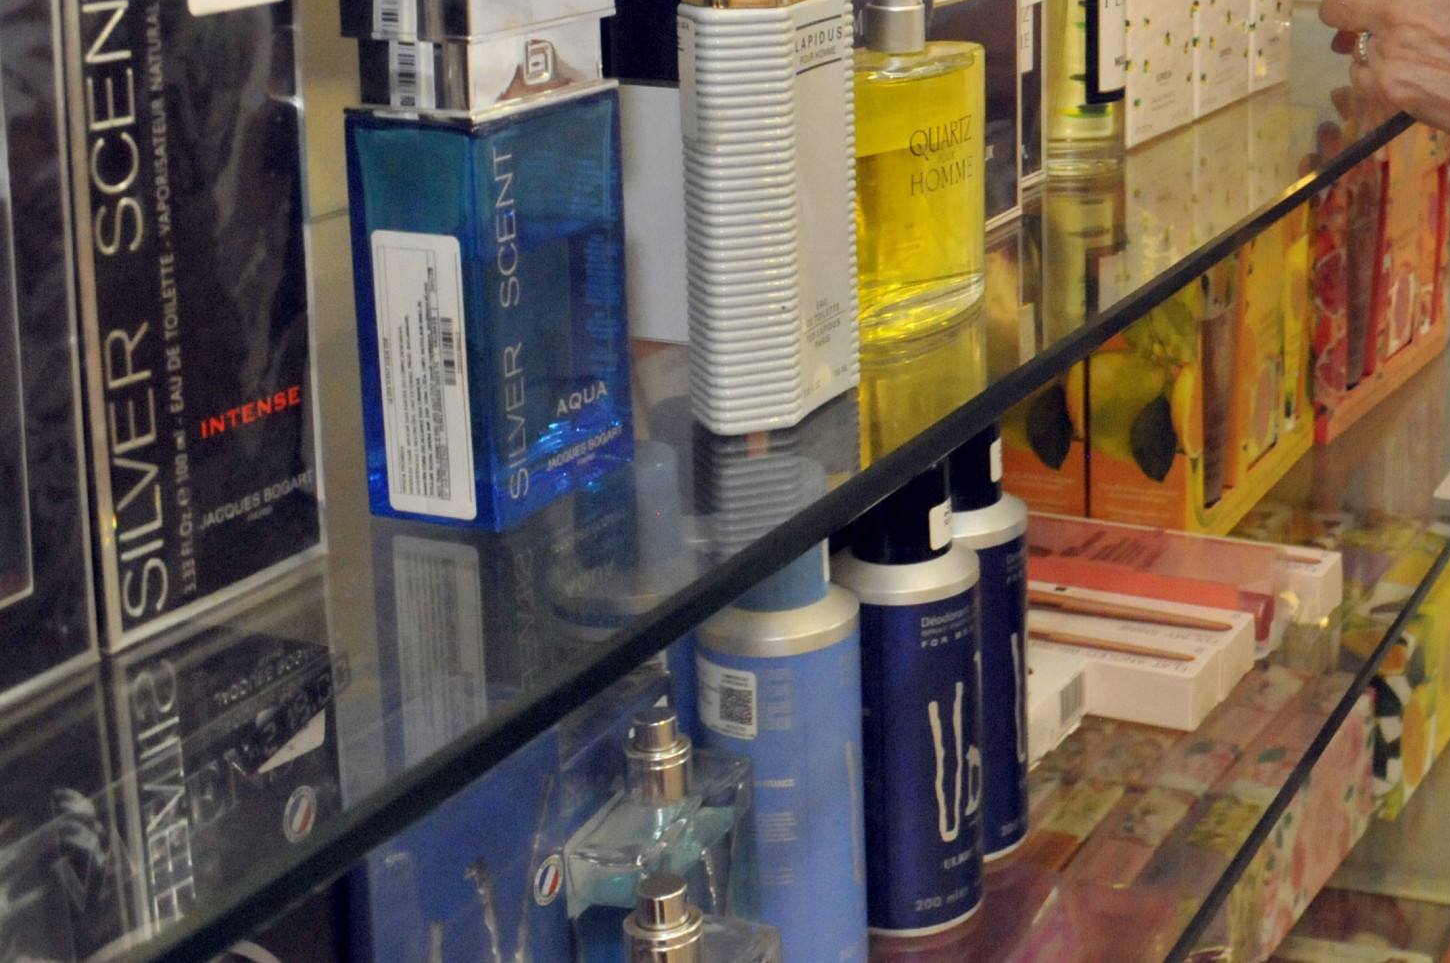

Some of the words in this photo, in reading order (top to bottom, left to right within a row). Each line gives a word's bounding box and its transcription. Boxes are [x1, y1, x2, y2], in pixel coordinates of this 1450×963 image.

[795, 26, 843, 53] LAPIDUS
[909, 114, 972, 161] QUARTZ
[910, 155, 973, 197] HOMME
[492, 146, 520, 308] SCENT
[160, 254, 178, 341] TOILETTE
[166, 345, 181, 370] DE
[170, 376, 184, 413] EAU
[200, 385, 300, 439] INTENSE
[556, 380, 608, 417] AQUA
[504, 342, 529, 500] SILVER
[103, 320, 169, 618] SILVER
[201, 492, 262, 531] JACQUES
[263, 469, 313, 503] BOGART
[915, 896, 942, 911] 200
